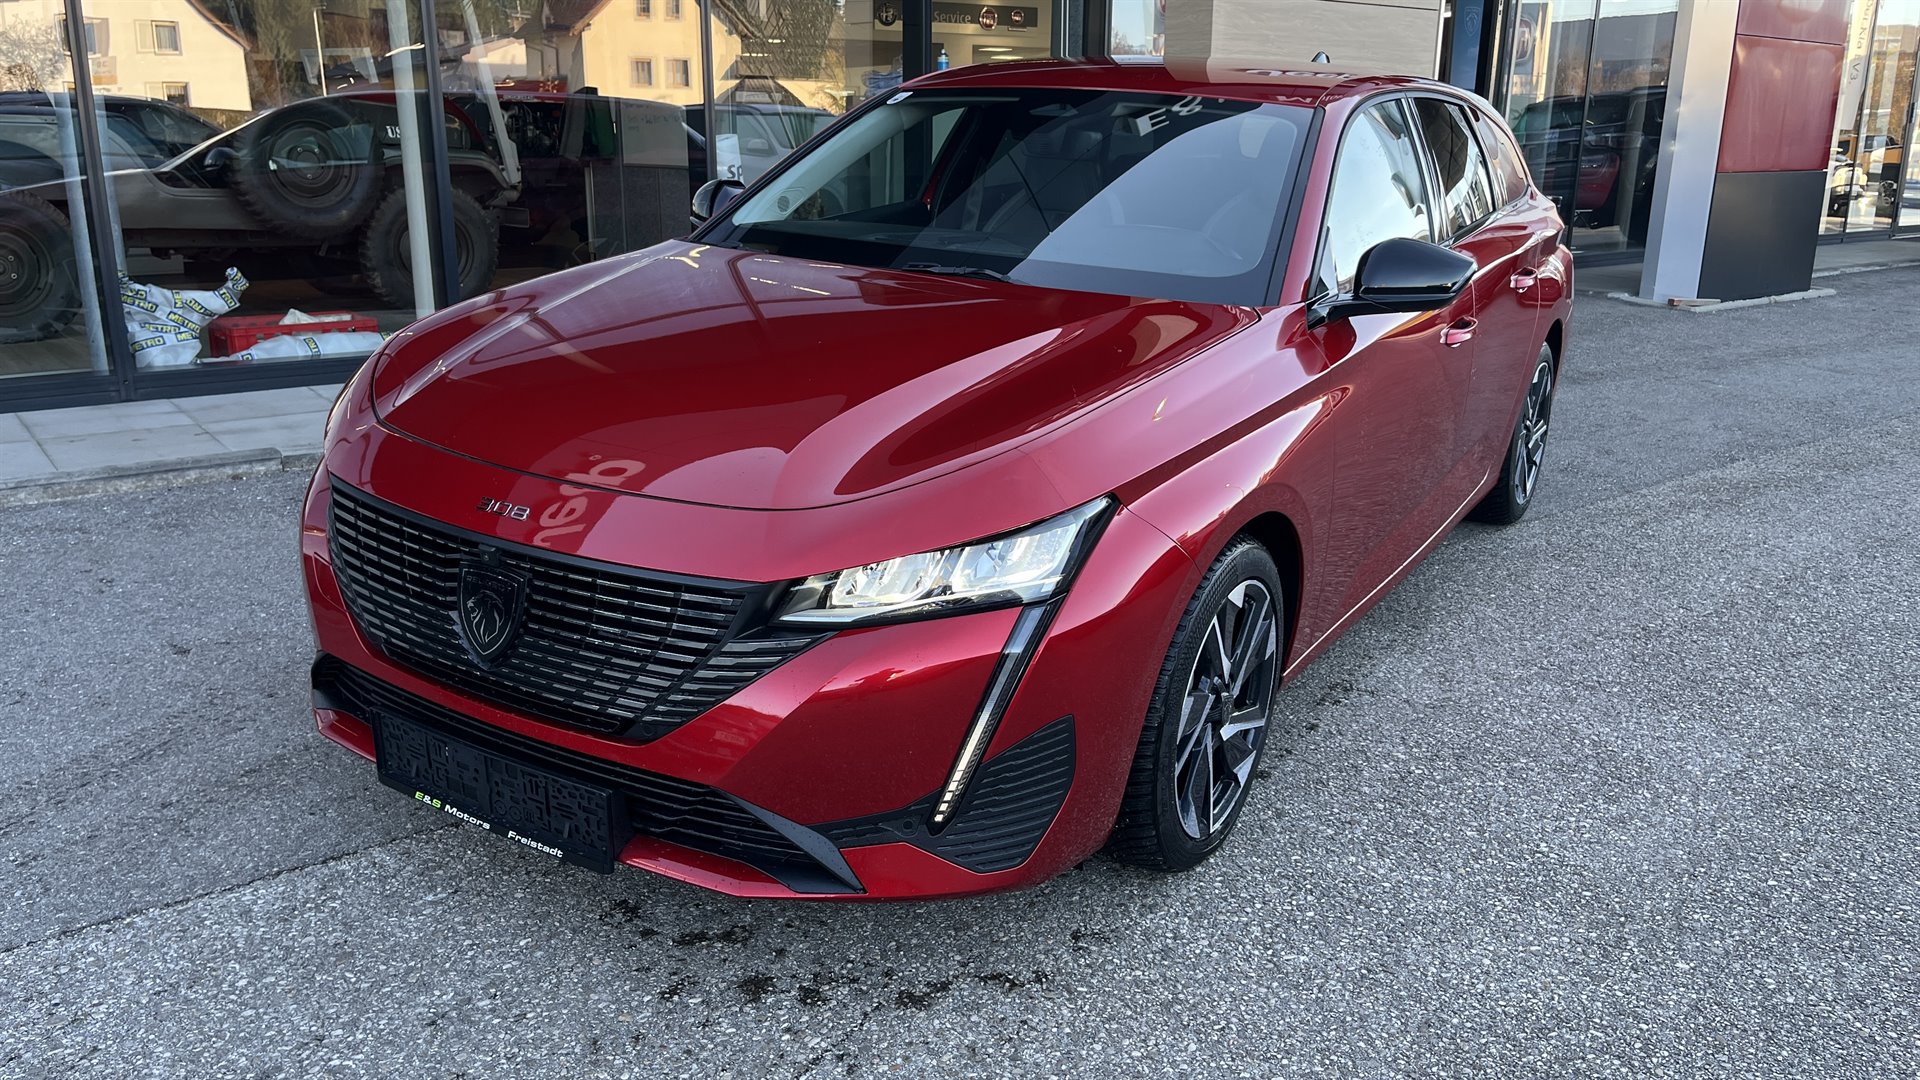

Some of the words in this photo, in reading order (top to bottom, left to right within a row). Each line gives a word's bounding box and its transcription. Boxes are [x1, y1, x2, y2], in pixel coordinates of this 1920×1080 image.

[934, 11, 972, 24] Service
[167, 311, 201, 333] METRO
[476, 496, 531, 521] 308
[414, 791, 442, 808] E&S
[444, 804, 491, 830] Motors
[507, 830, 563, 858] Freistadt
